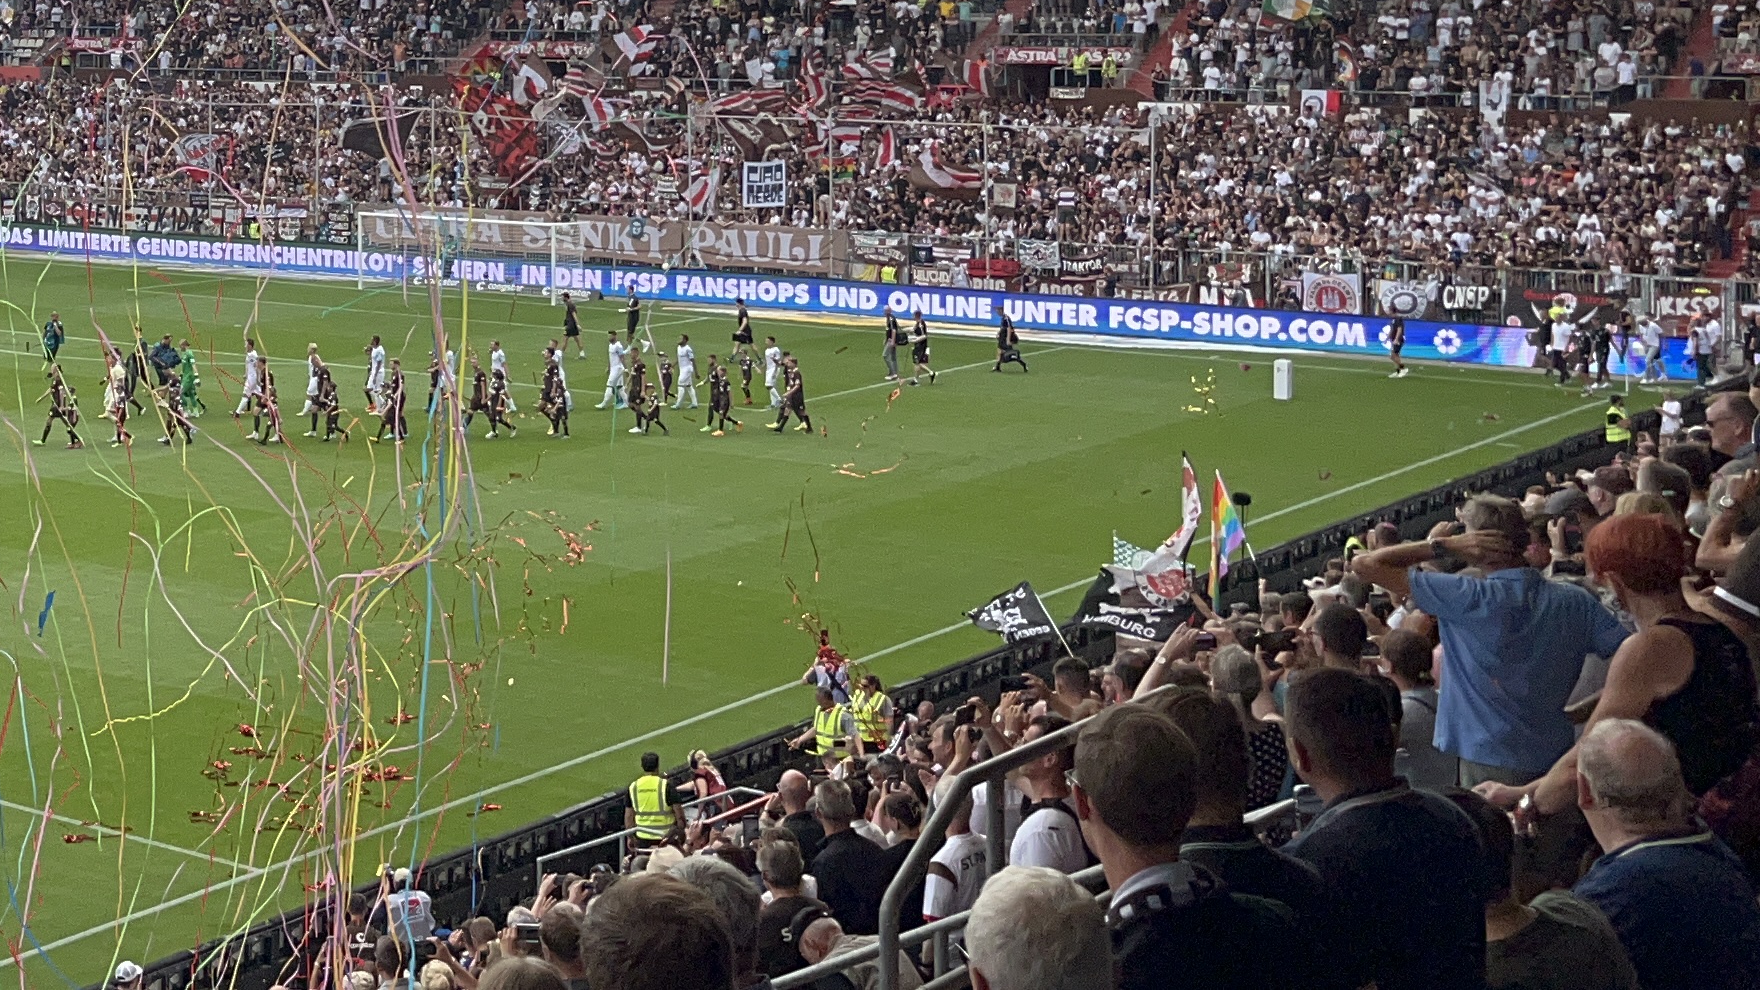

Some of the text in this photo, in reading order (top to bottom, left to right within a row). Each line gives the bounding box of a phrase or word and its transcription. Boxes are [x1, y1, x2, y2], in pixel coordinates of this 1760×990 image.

[1006, 48, 1057, 62] ASTRA
[746, 164, 784, 183] CIAO
[691, 227, 824, 266] PAULI
[38, 229, 130, 253] LIMITIERTE
[521, 264, 546, 285] IN
[555, 267, 601, 289] DEN
[612, 271, 667, 294] FCSP
[676, 275, 810, 305] FANSHOPS
[819, 285, 878, 310] UND
[888, 290, 992, 319] ONLINE
[1003, 298, 1098, 327] UNTER
[1108, 306, 1367, 347] FCSP-SHOP.COM
[1443, 284, 1490, 309] CNSP
